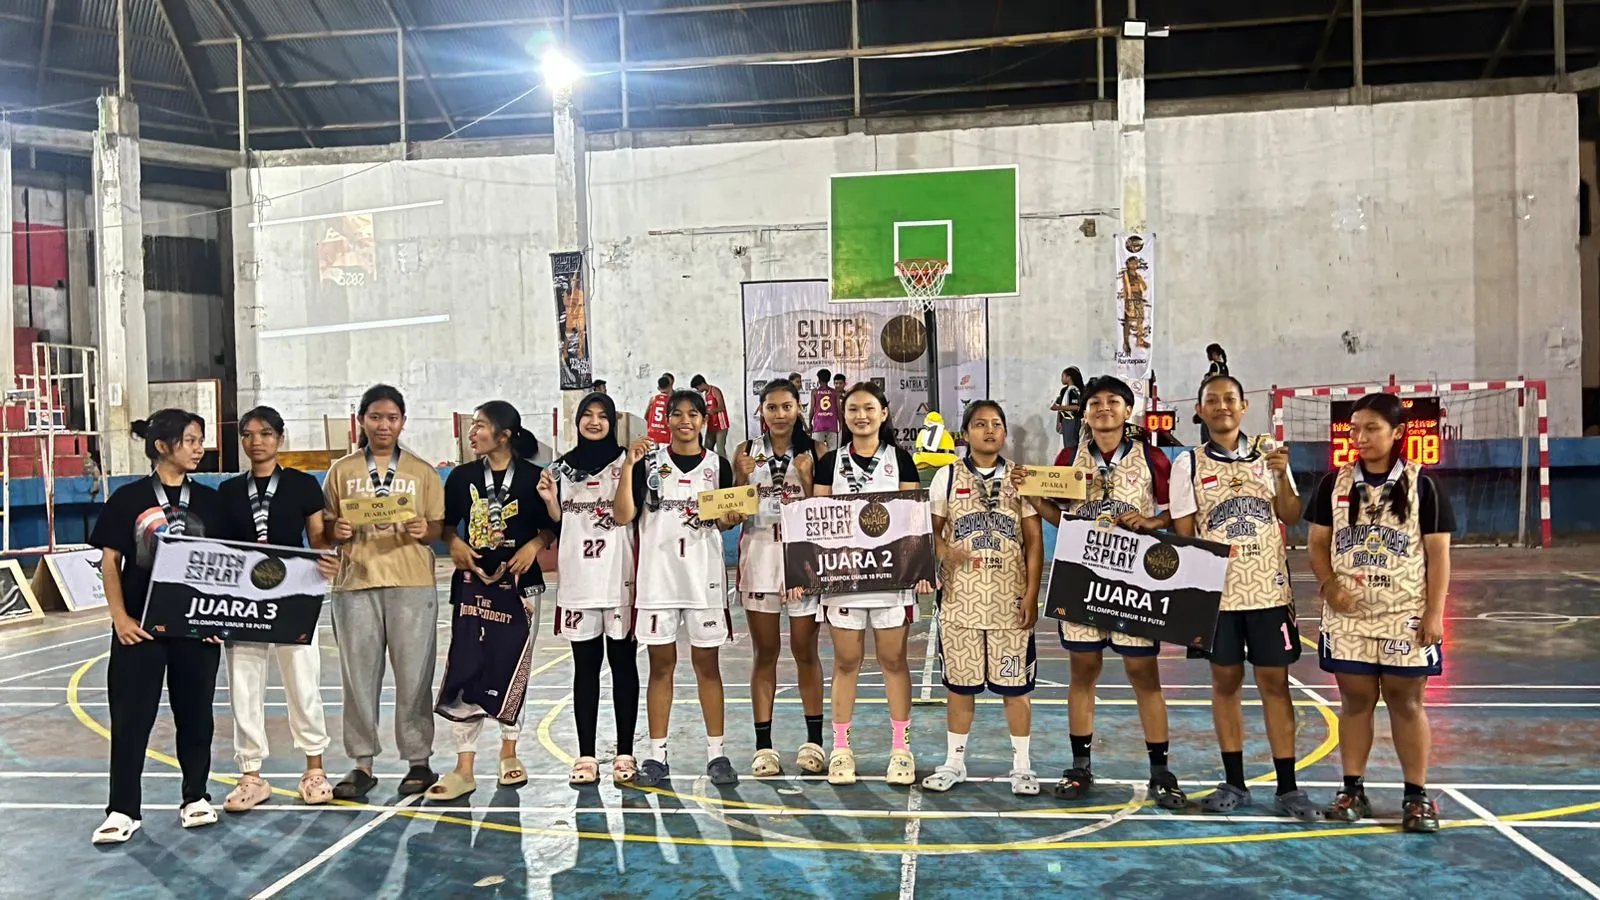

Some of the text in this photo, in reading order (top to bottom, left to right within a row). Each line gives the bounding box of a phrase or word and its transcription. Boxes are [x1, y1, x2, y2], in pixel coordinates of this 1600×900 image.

[798, 319, 867, 337] CLUTCH
[821, 339, 867, 358] PLAY
[900, 379, 922, 390] SATRIA
[820, 396, 831, 411] 6
[654, 407, 664, 422] 5
[1408, 435, 1439, 464] 08
[805, 505, 851, 521] CLUTCH
[822, 520, 851, 535] PLAY
[1226, 522, 1256, 539] ZONE
[583, 539, 606, 558] 27
[679, 538, 685, 557] 1
[972, 536, 1000, 551] ZONE
[1086, 530, 1140, 553] CLUTCH
[189, 550, 247, 569] CLUTCH
[816, 550, 893, 576] JUARA 2
[1100, 548, 1136, 568] PLAY
[1353, 551, 1387, 568] ZONE
[204, 566, 243, 583] PLAY
[475, 595, 492, 608] THE
[1083, 581, 1170, 614] JUARA 1
[185, 597, 278, 620] JUARA 3
[1086, 605, 1166, 626] KELOMPOK UMUR 18 PUTRI
[188, 619, 224, 627] KELOMPOK
[225, 620, 245, 628] UMUR
[565, 610, 583, 629] 27
[650, 614, 658, 634] 1
[1280, 622, 1293, 651] 1
[1384, 640, 1410, 655] 24
[1000, 656, 1020, 677] 21
